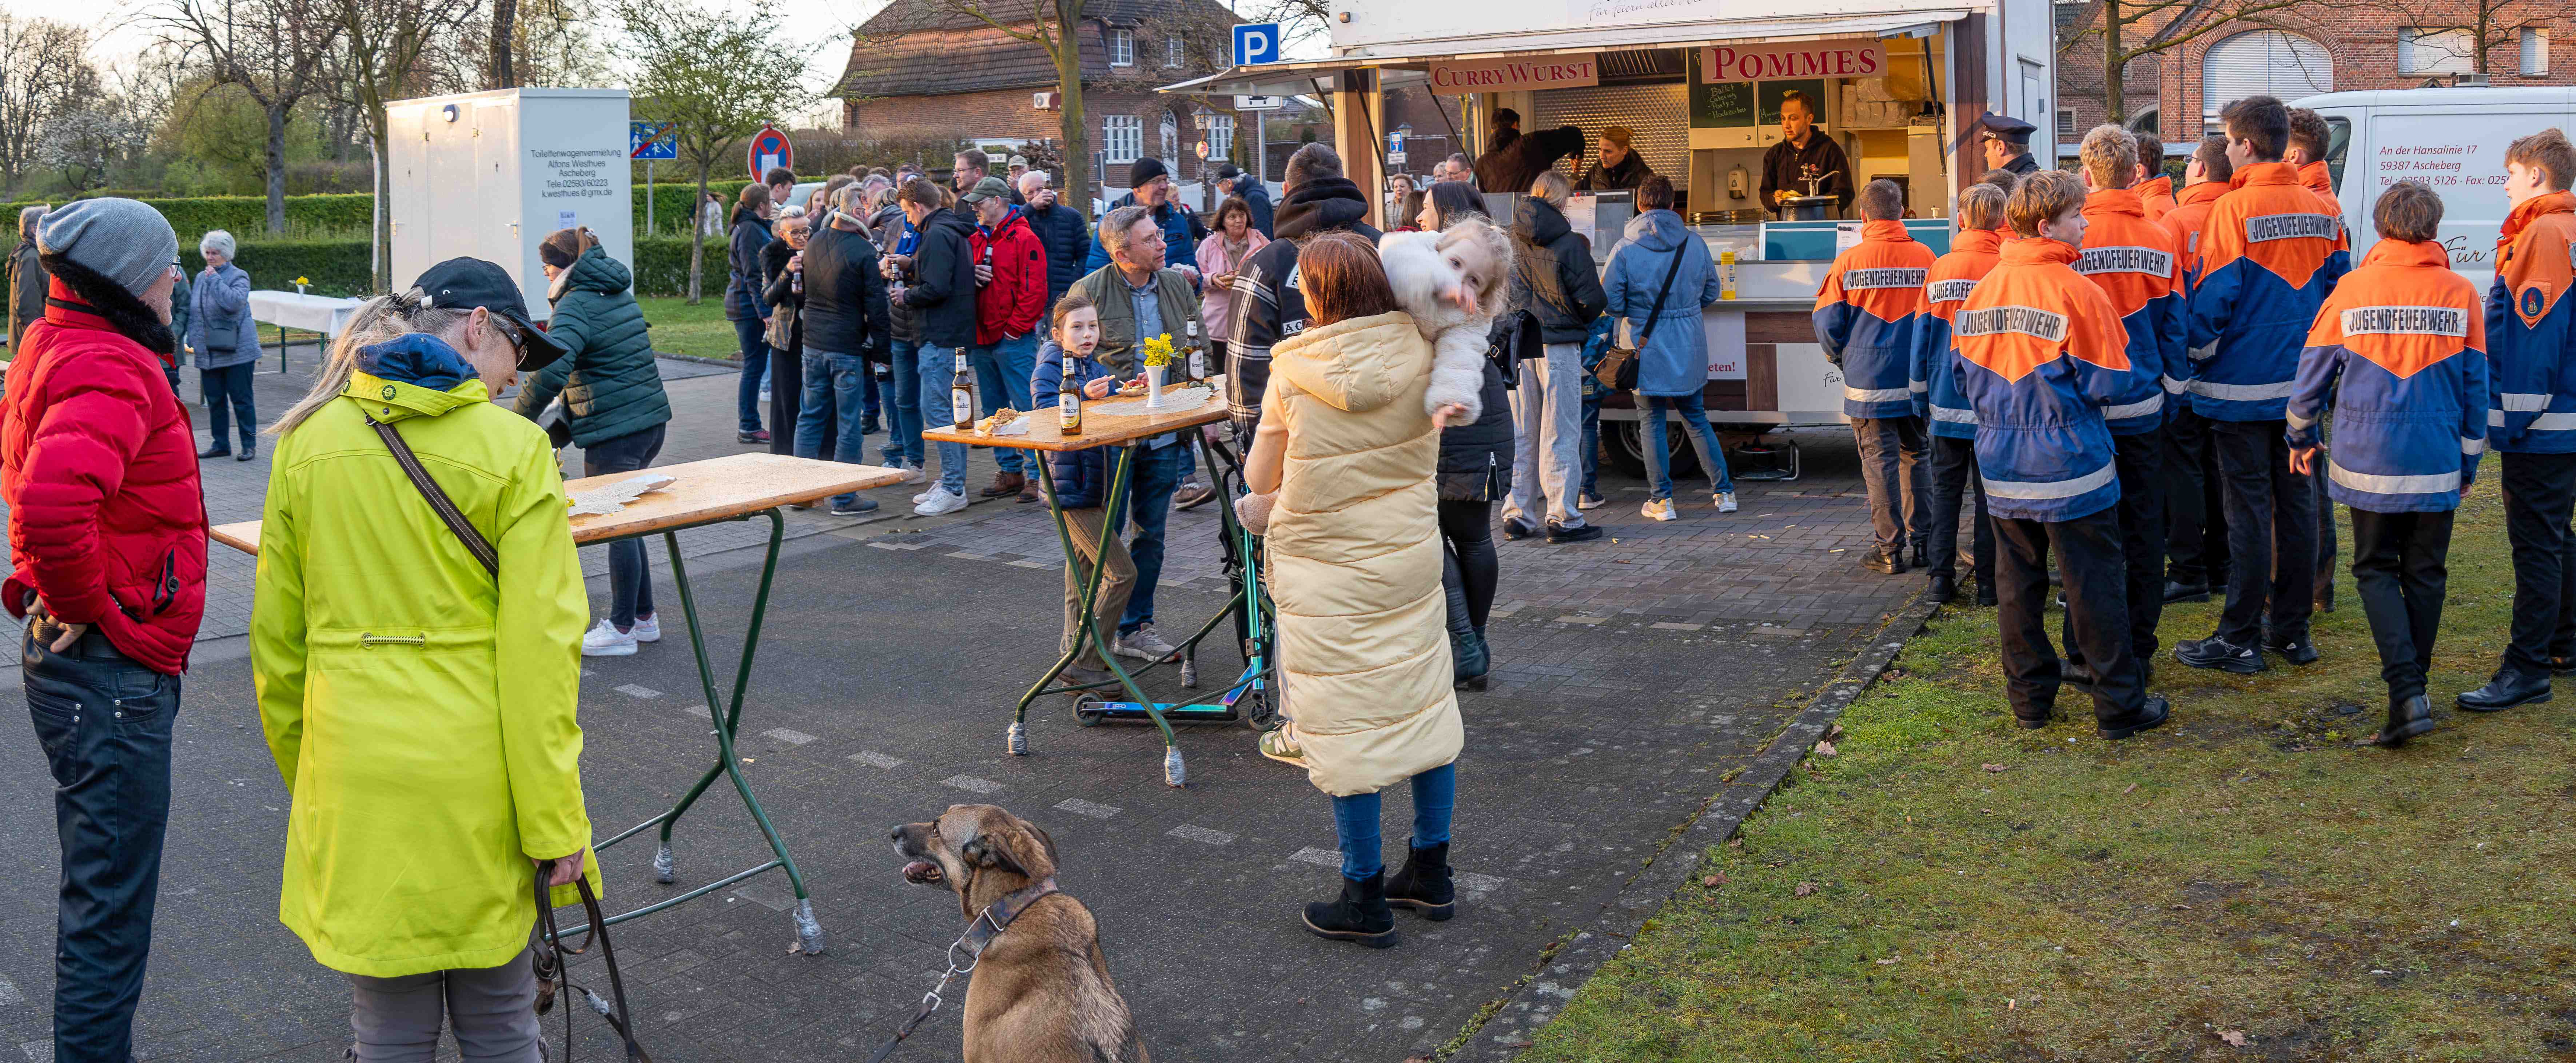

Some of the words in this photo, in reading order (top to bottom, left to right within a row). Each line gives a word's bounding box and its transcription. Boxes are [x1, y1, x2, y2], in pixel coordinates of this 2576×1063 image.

[1245, 31, 1268, 64] P
[531, 148, 621, 158] Toilettenwagenvermietung
[2380, 146, 2393, 155] An
[2396, 146, 2411, 155] der
[2413, 145, 2462, 155] Hansalinie
[2467, 145, 2477, 154] 17
[572, 159, 606, 167] Westhues
[2380, 161, 2410, 170] 59387
[2413, 160, 2461, 172] Ascheberg
[559, 169, 596, 177] Ascheberg
[2434, 176, 2457, 185] 5126
[2465, 176, 2485, 185] Fax:
[2488, 176, 2509, 184] 025
[2445, 236, 2487, 263] Für
[2349, 308, 2458, 333] JUGENDFEUERWEHR
